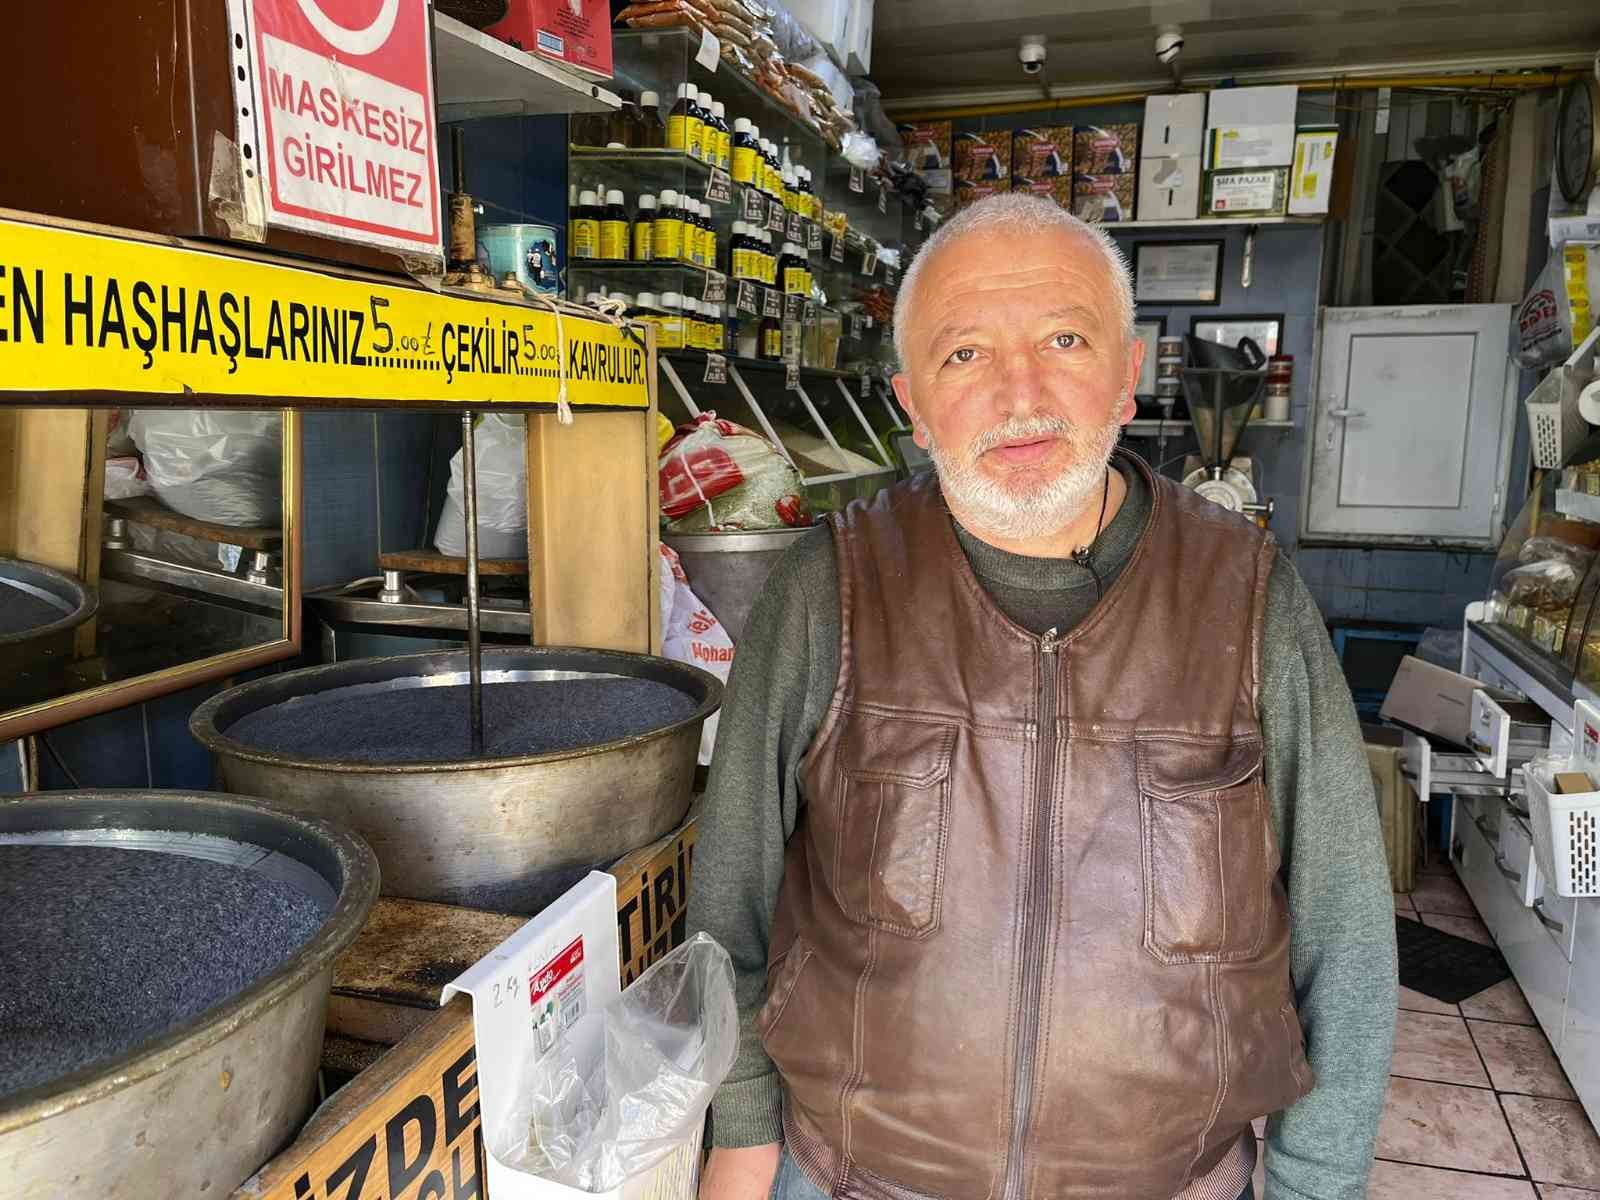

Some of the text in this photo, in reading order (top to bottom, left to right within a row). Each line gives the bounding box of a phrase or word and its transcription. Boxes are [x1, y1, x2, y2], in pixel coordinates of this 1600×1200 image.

[269, 67, 426, 156] MASKESİZ
[283, 132, 424, 209] GİRİLMEZ
[64, 271, 366, 375] HAŞHAŞLARINIZ
[441, 317, 520, 384] ÇEKİLİR
